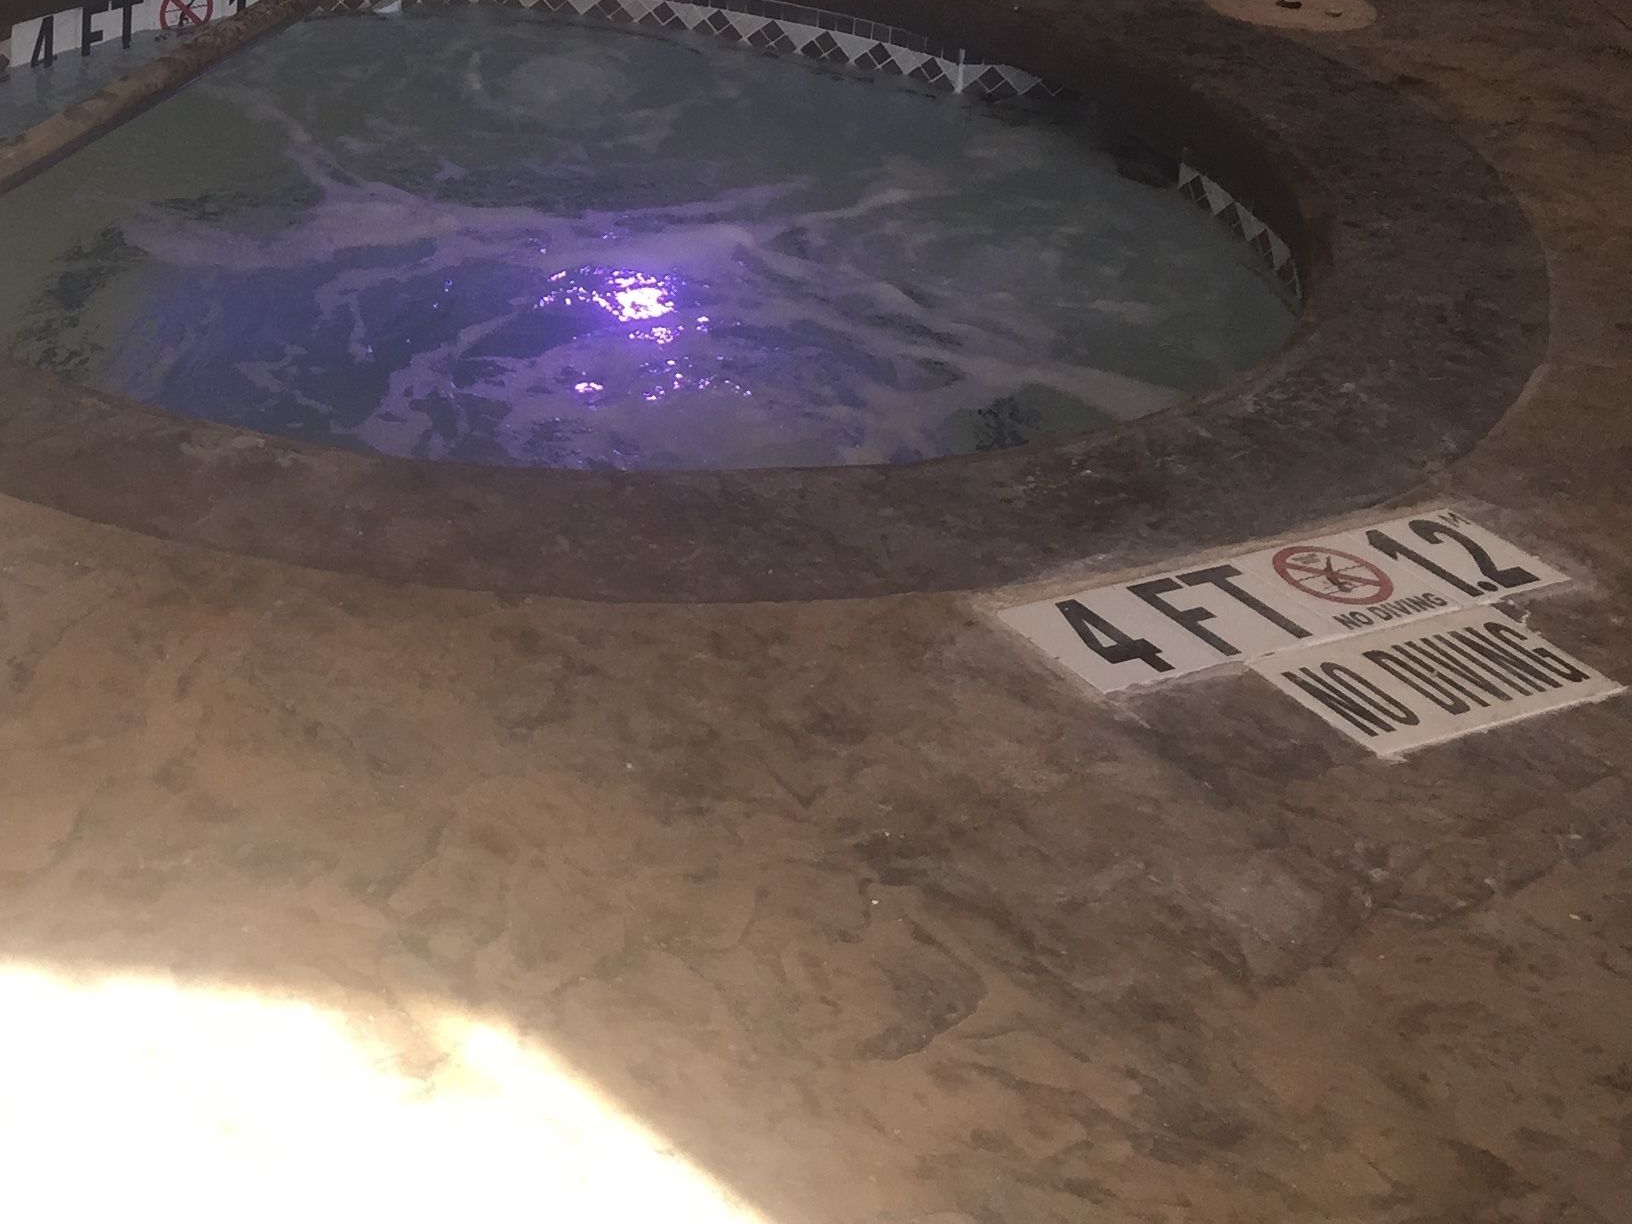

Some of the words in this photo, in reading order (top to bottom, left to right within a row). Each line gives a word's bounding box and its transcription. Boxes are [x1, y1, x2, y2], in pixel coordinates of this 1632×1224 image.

[30, 15, 61, 68] 4
[1055, 598, 1176, 673] 4
[1125, 564, 1312, 657] FT
[1332, 610, 1375, 630] NO
[1366, 592, 1448, 621] DIVING
[1280, 661, 1421, 738] NO
[1361, 621, 1591, 716] DIVING
